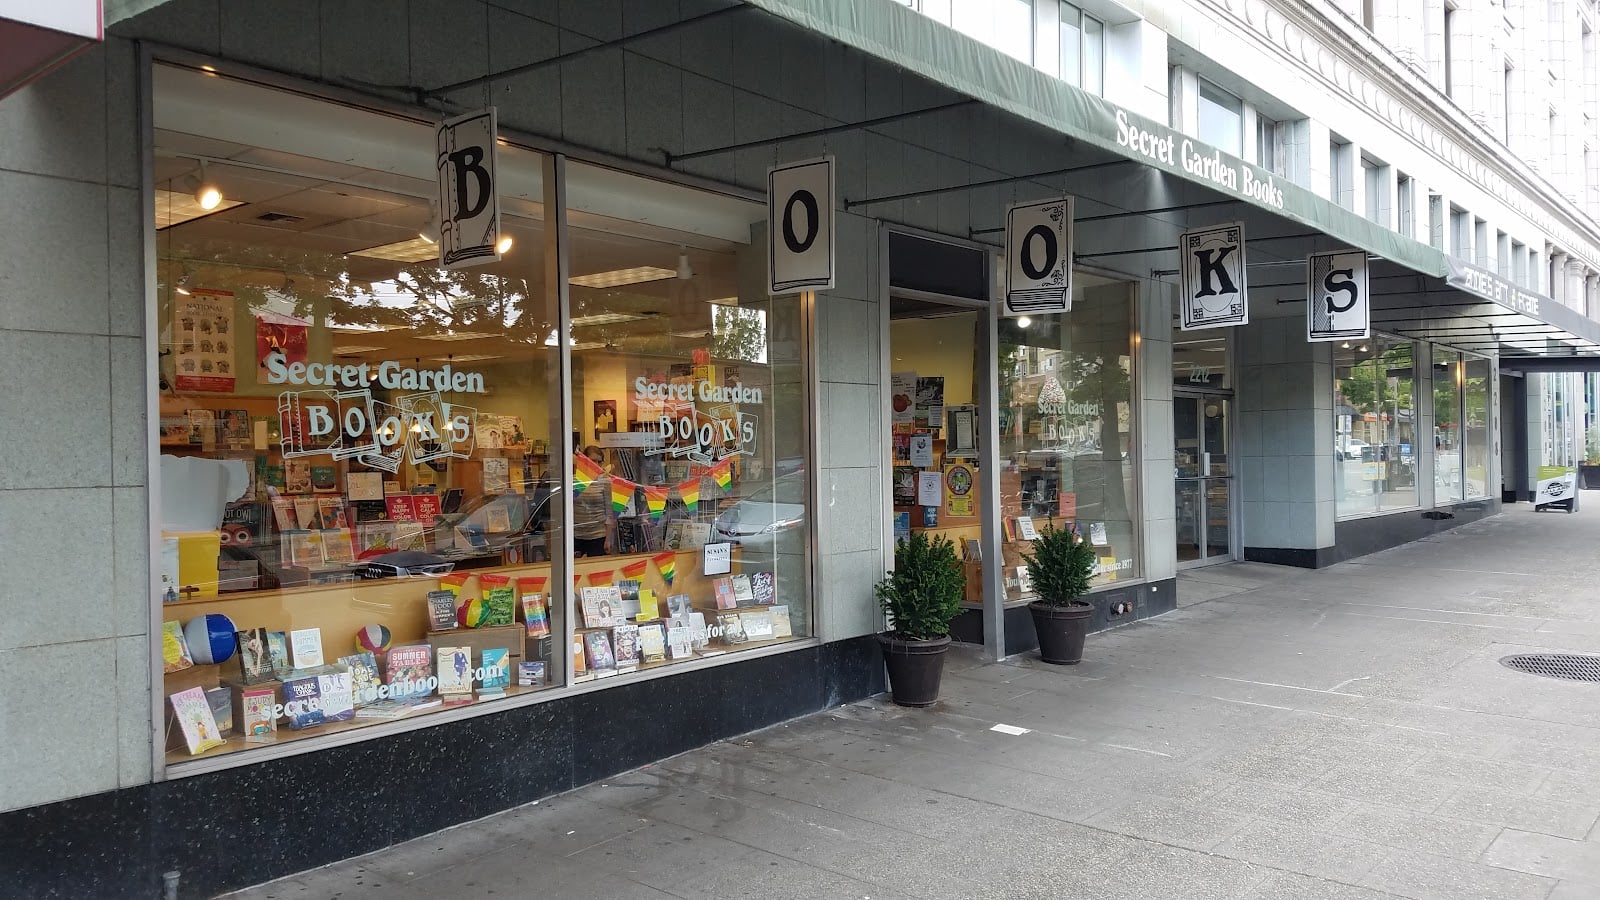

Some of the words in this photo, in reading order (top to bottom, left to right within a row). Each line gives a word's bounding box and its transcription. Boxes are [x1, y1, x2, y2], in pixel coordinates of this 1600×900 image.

[1115, 109, 1174, 166] Secret
[1181, 139, 1237, 191] Garden
[1242, 165, 1284, 209] Books
[268, 353, 370, 387] Secret
[379, 361, 485, 393] Garden
[635, 376, 695, 402] Secret
[699, 380, 763, 404] Garden
[1038, 400, 1066, 416] Secret
[1068, 400, 1099, 417] Garden
[707, 624, 724, 639] for
[392, 650, 426, 661] SUMMER
